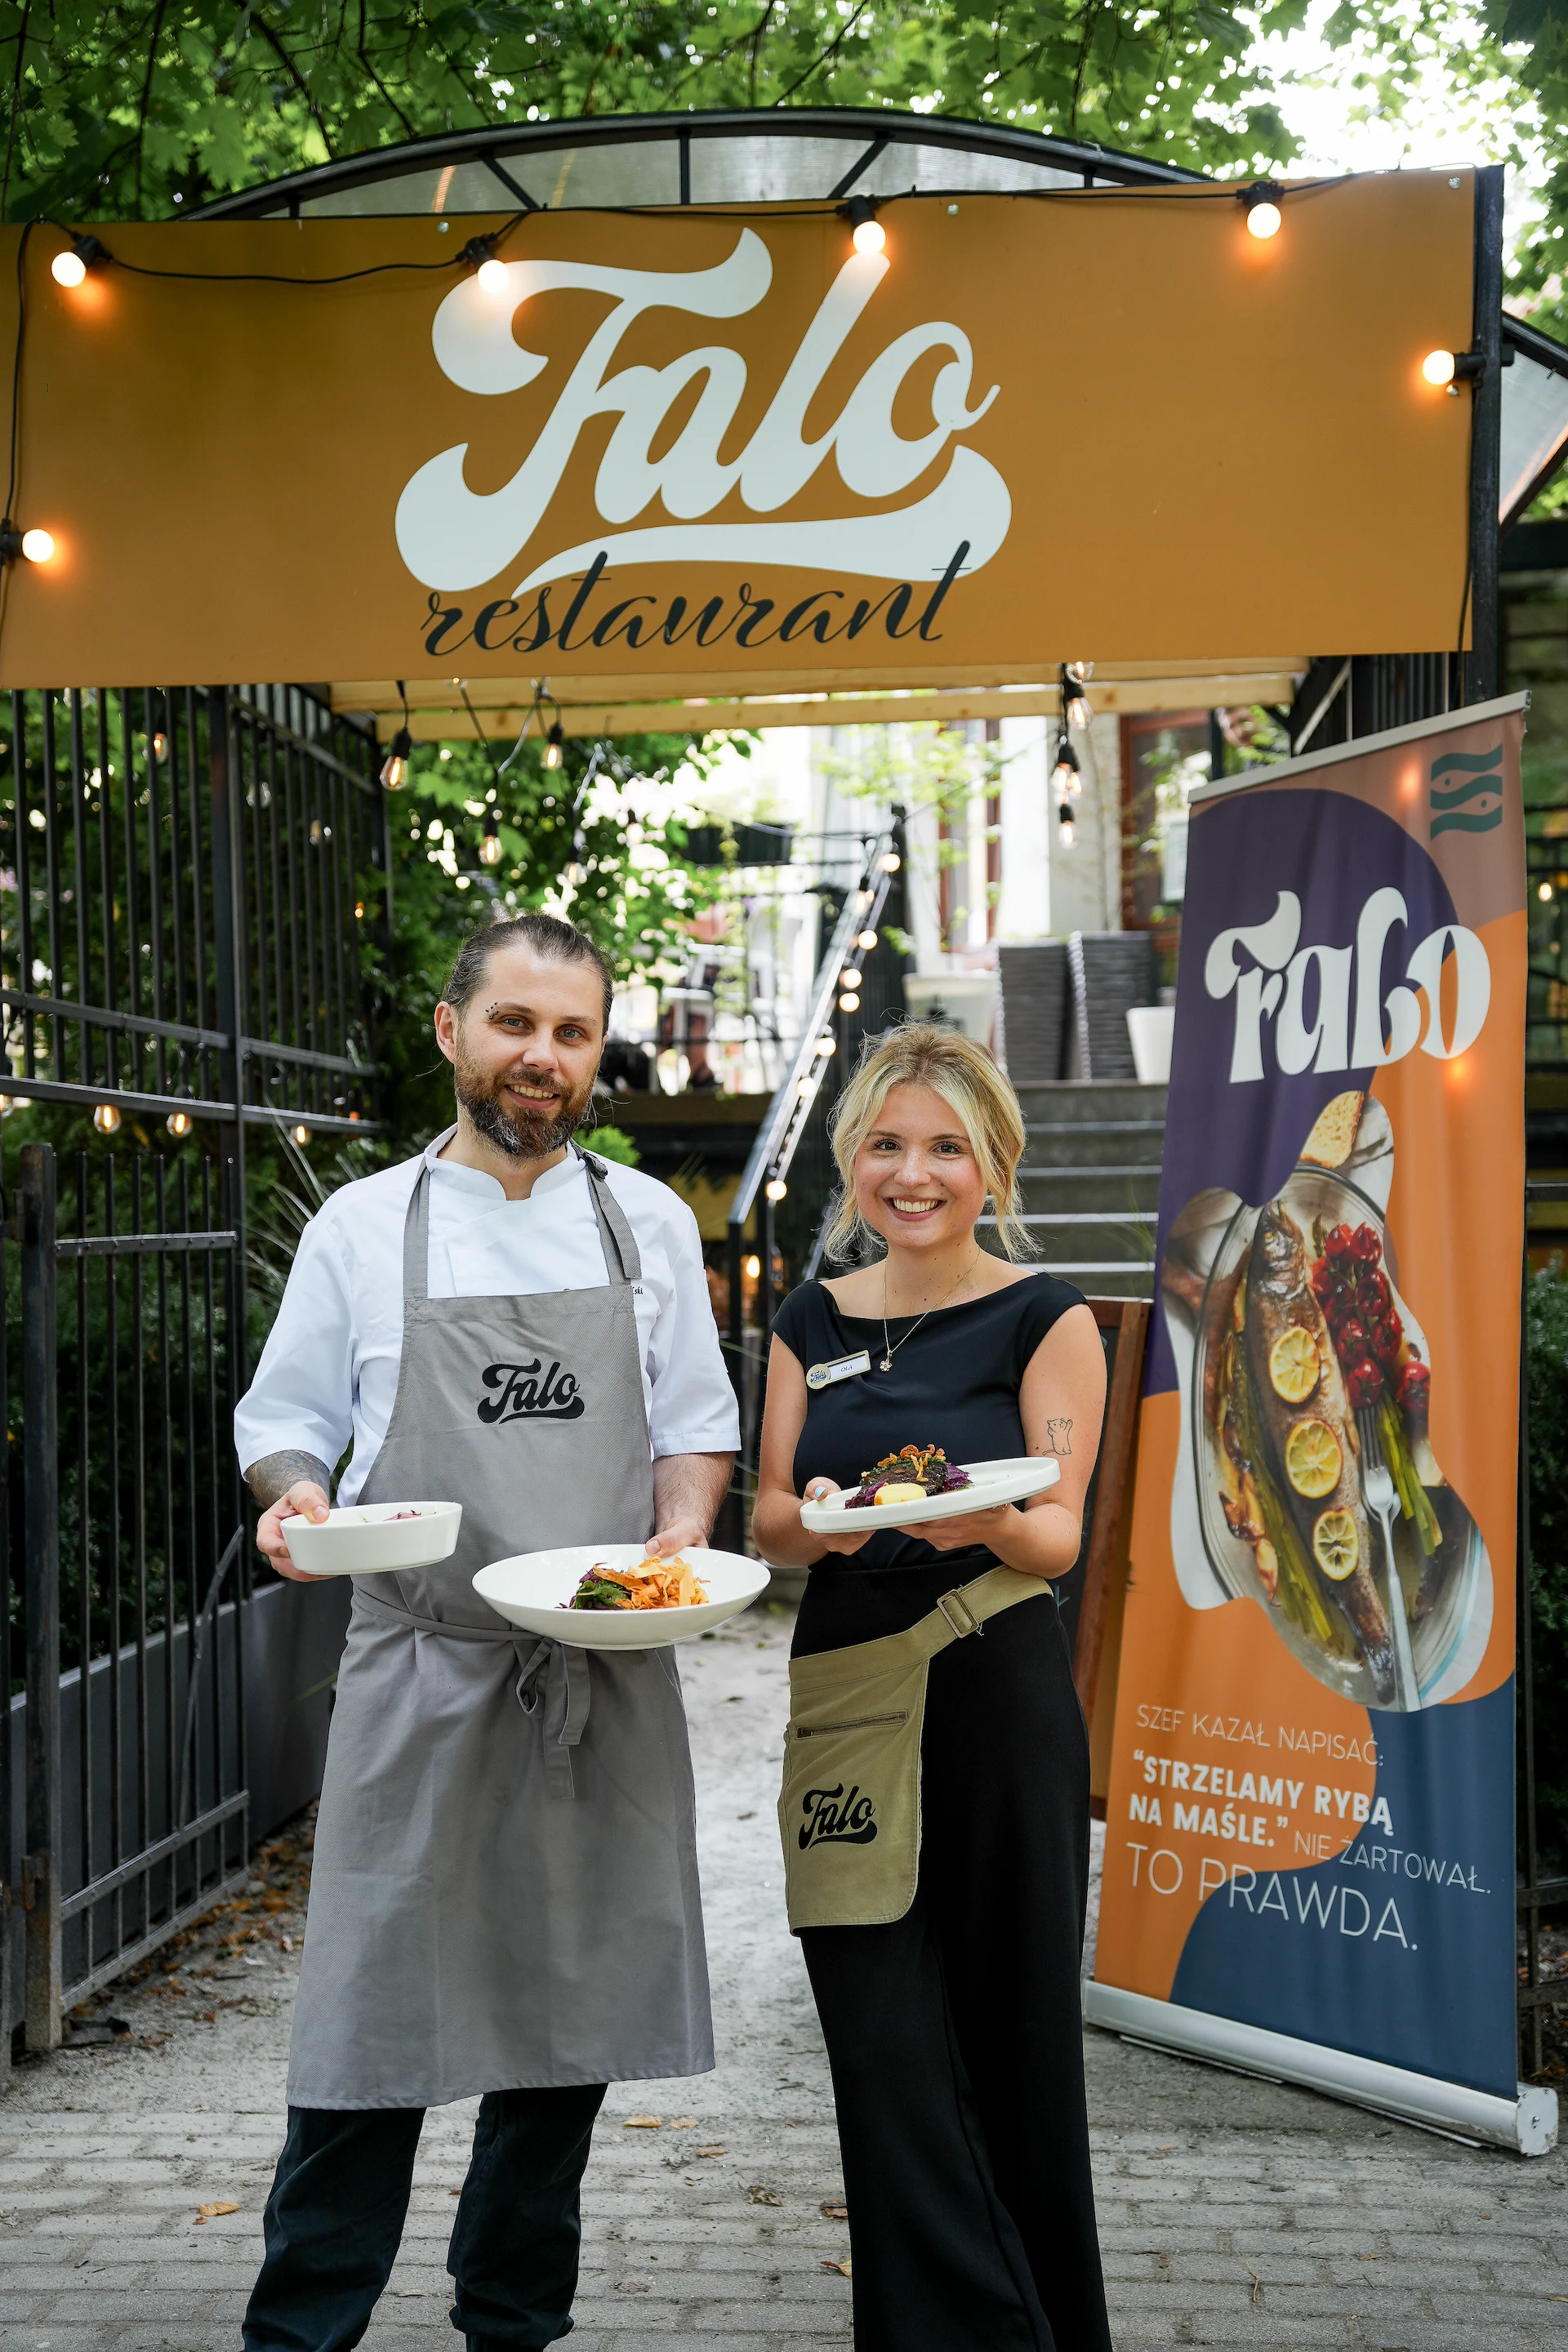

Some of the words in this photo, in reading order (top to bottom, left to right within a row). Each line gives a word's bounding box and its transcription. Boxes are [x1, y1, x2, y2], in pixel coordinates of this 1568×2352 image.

[394, 226, 1013, 599] Falo
[420, 540, 972, 657] restaurant
[477, 1358, 585, 1425] Falo
[1136, 1704, 1185, 1732] SZEF
[1193, 1713, 1271, 1748] KAZAŁ
[1278, 1726, 1384, 1766] NAPISAĆ:
[798, 1783, 878, 1851] Falo
[1129, 1793, 1163, 1827] NA
[1294, 1829, 1333, 1861] NIE
[1340, 1835, 1491, 1895] ŻARTOWAŁ.
[1314, 1785, 1395, 1837] RYBĄ
[1127, 1842, 1183, 1895] TO
[1198, 1857, 1419, 1951] PRAWDA.
